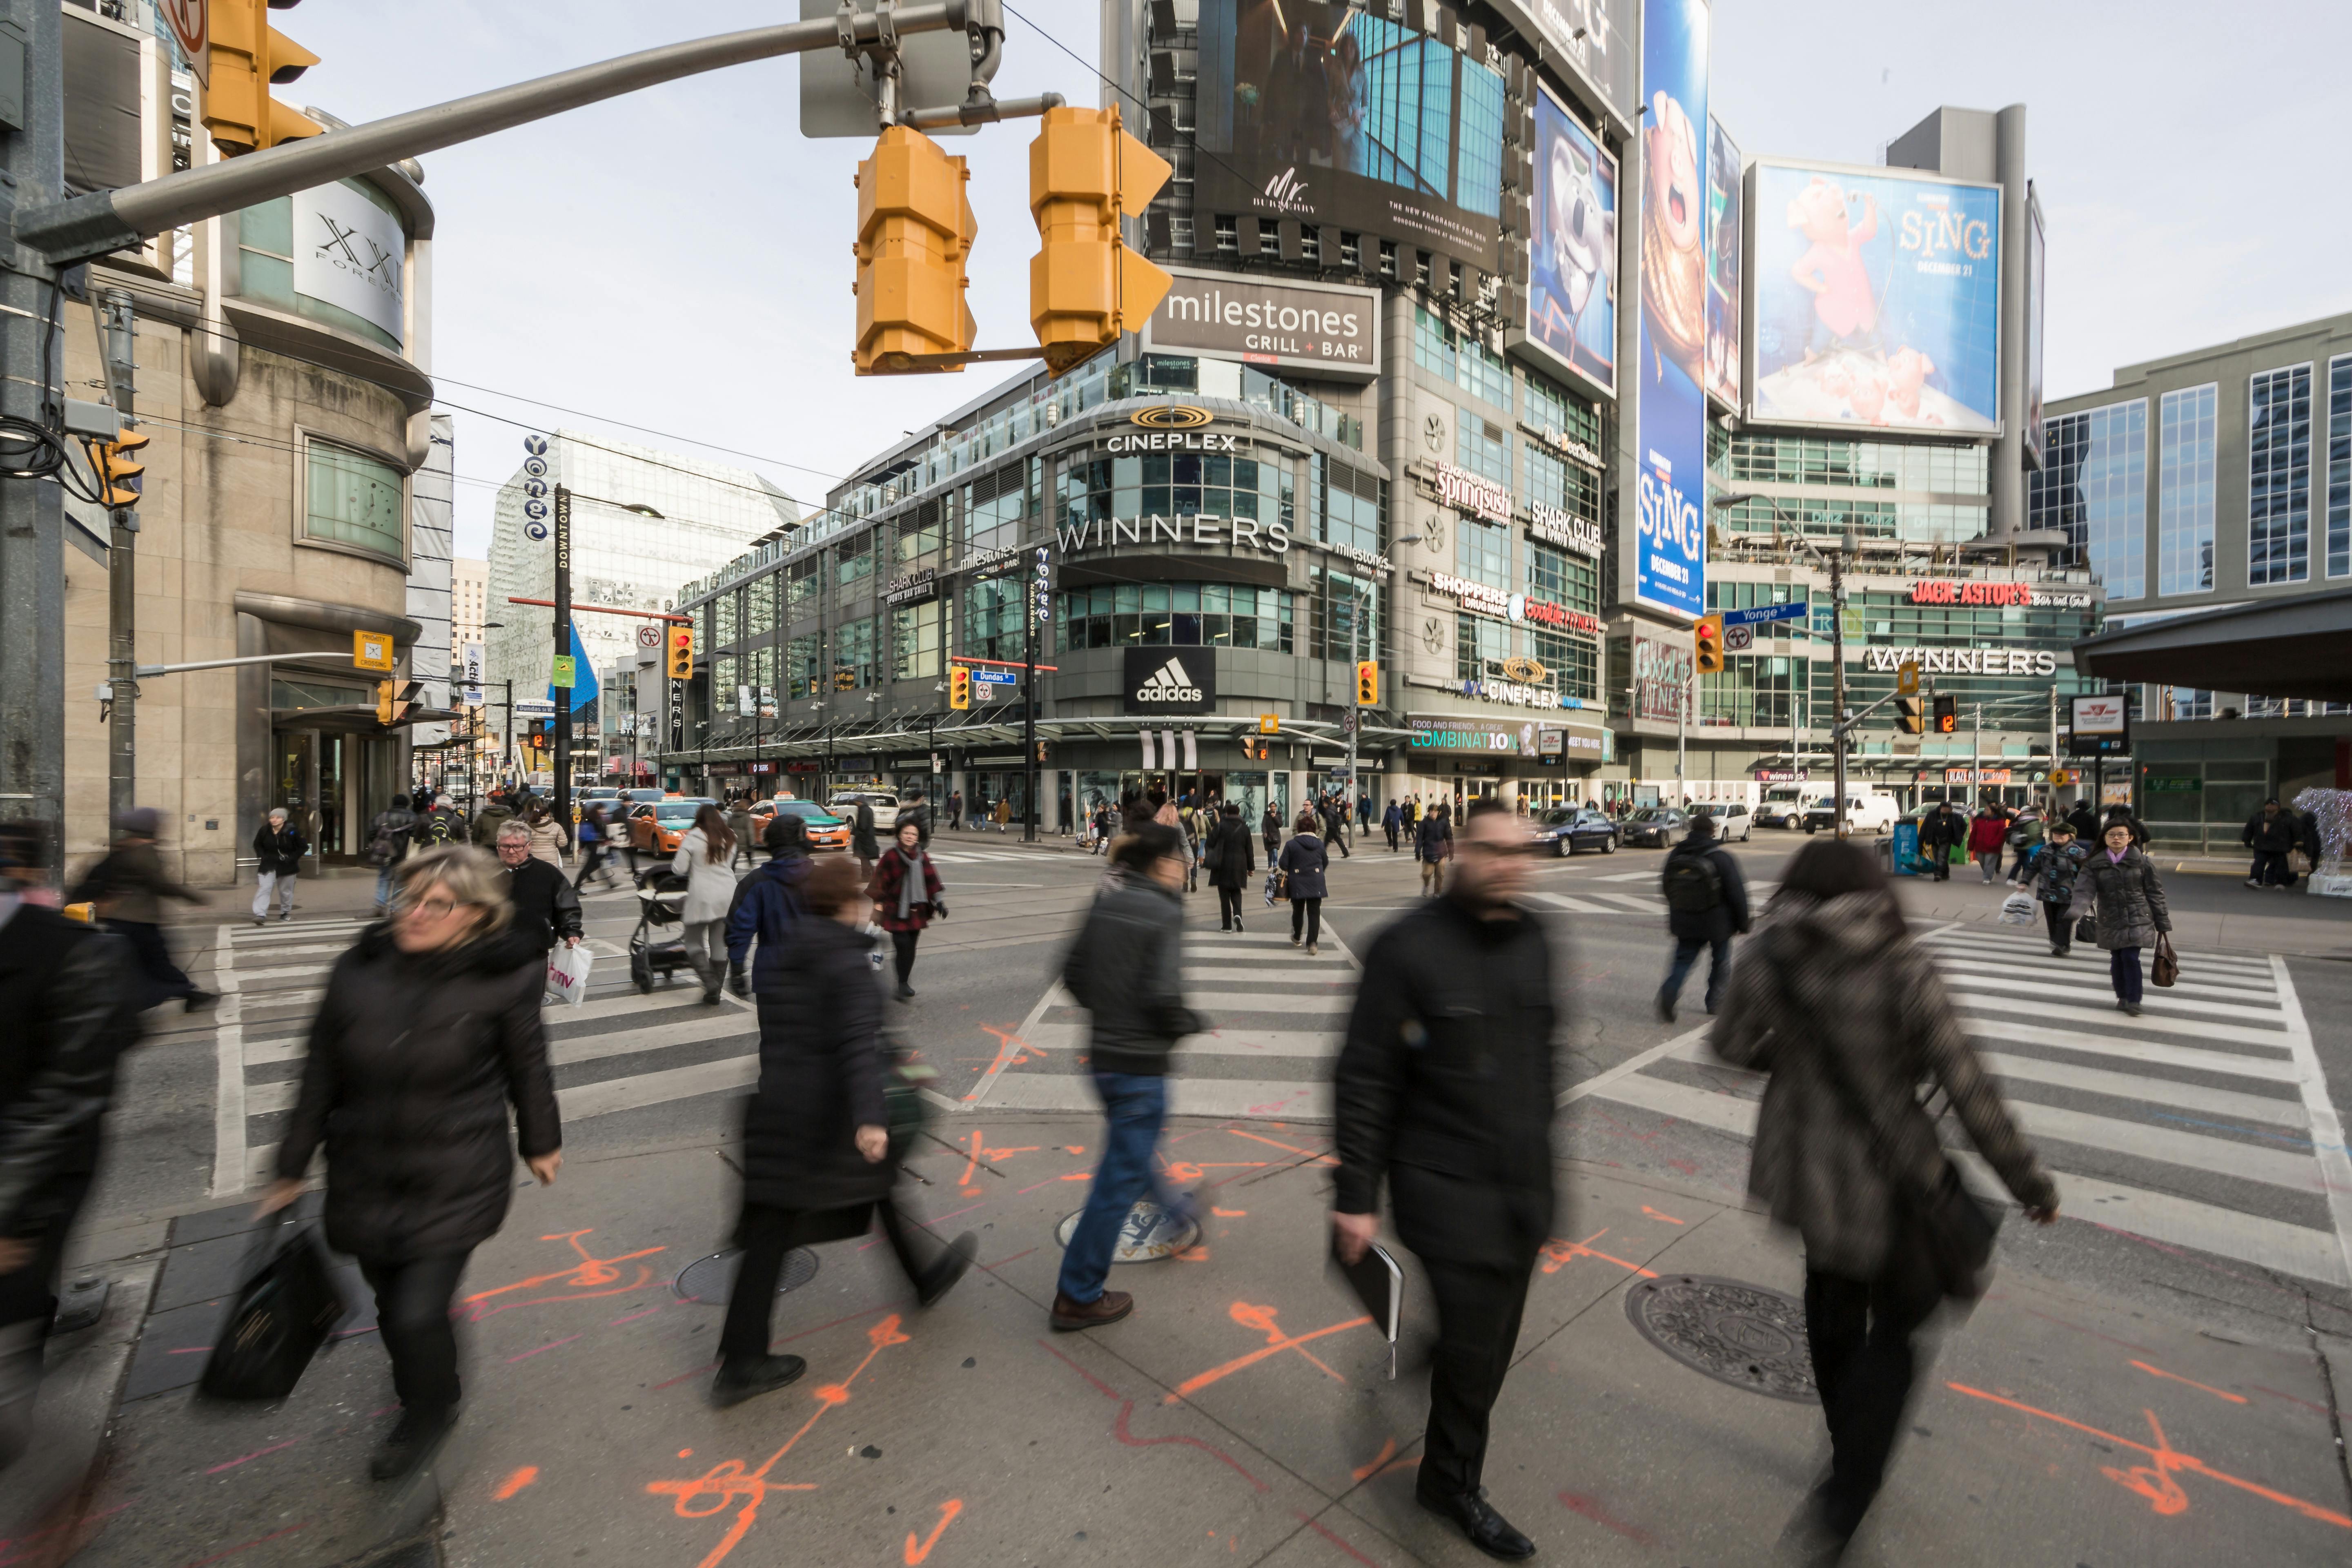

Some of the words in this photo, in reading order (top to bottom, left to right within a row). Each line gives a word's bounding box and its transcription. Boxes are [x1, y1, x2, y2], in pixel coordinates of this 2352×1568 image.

[1265, 167, 1308, 213] Mr.
[1254, 198, 1316, 214] BURBERRY
[1389, 200, 1403, 212] THE
[1405, 205, 1420, 216] NEW
[1422, 211, 1460, 232] FRAGRANCE
[1462, 225, 1473, 237] FOR
[1475, 232, 1486, 243] MEN
[1393, 216, 1423, 230] MONOGRAM
[1425, 226, 1441, 236] YOURS
[1442, 231, 1448, 239] AT
[1449, 234, 1483, 254] BURBERRY.COM
[1900, 210, 1991, 260] SING
[315, 212, 402, 297] XXI
[1917, 261, 1961, 276] DECEMBER
[1962, 264, 1973, 277] 21
[1168, 290, 1359, 338] milestones
[1245, 334, 1300, 354] GRILL
[1107, 433, 1236, 452] CINEPLEX
[1532, 499, 1572, 536] SHARK
[1573, 517, 1601, 548] CLUB
[1639, 472, 1701, 562] SING
[1811, 510, 1844, 524] DMZ
[1863, 513, 1895, 526] DMZ
[559, 495, 568, 569] DOWNTOWN
[1056, 513, 1290, 553] WINNERS
[960, 542, 1016, 571] milestones
[1336, 541, 1388, 570] milestones
[889, 577, 912, 593] SHARK
[914, 568, 933, 584] CLUB
[1356, 563, 1372, 575] GRILL
[1376, 569, 1388, 580] BAR
[1650, 553, 1682, 584] DECEMBER
[1682, 568, 1689, 585] 21
[886, 591, 903, 605] SPORTS
[904, 587, 913, 598] BAR
[914, 585, 927, 595] GRILL
[1432, 572, 1508, 606] SHOPPERS
[1912, 580, 1956, 604] JACK
[1960, 581, 2032, 606] ASTOR'S
[2031, 592, 2052, 606] Bar
[2053, 595, 2068, 606] and
[2069, 593, 2091, 608] Grill
[1464, 597, 1487, 611] DRUG
[1487, 603, 1507, 617] MART
[1743, 607, 1778, 621] Yonge
[1564, 611, 1598, 633] FITNESS
[362, 634, 386, 642] PRIORITY
[360, 659, 387, 668] CROSSING
[1871, 646, 2056, 676] WINNERS
[469, 659, 479, 692] Actin
[980, 672, 1004, 682] Dundas
[672, 680, 682, 727] NERS
[1137, 685, 1203, 702] adidas
[1488, 681, 1559, 710] CINEPLEX
[1562, 695, 1584, 710] IMAX
[1412, 720, 1432, 729] FOOD
[1433, 721, 1448, 730] AND
[1486, 723, 1504, 732] GREAT
[1942, 715, 1954, 732] 12
[1769, 771, 1788, 782] wine
[1949, 770, 1967, 783] BLAZE
[1967, 770, 1984, 783] PIA
